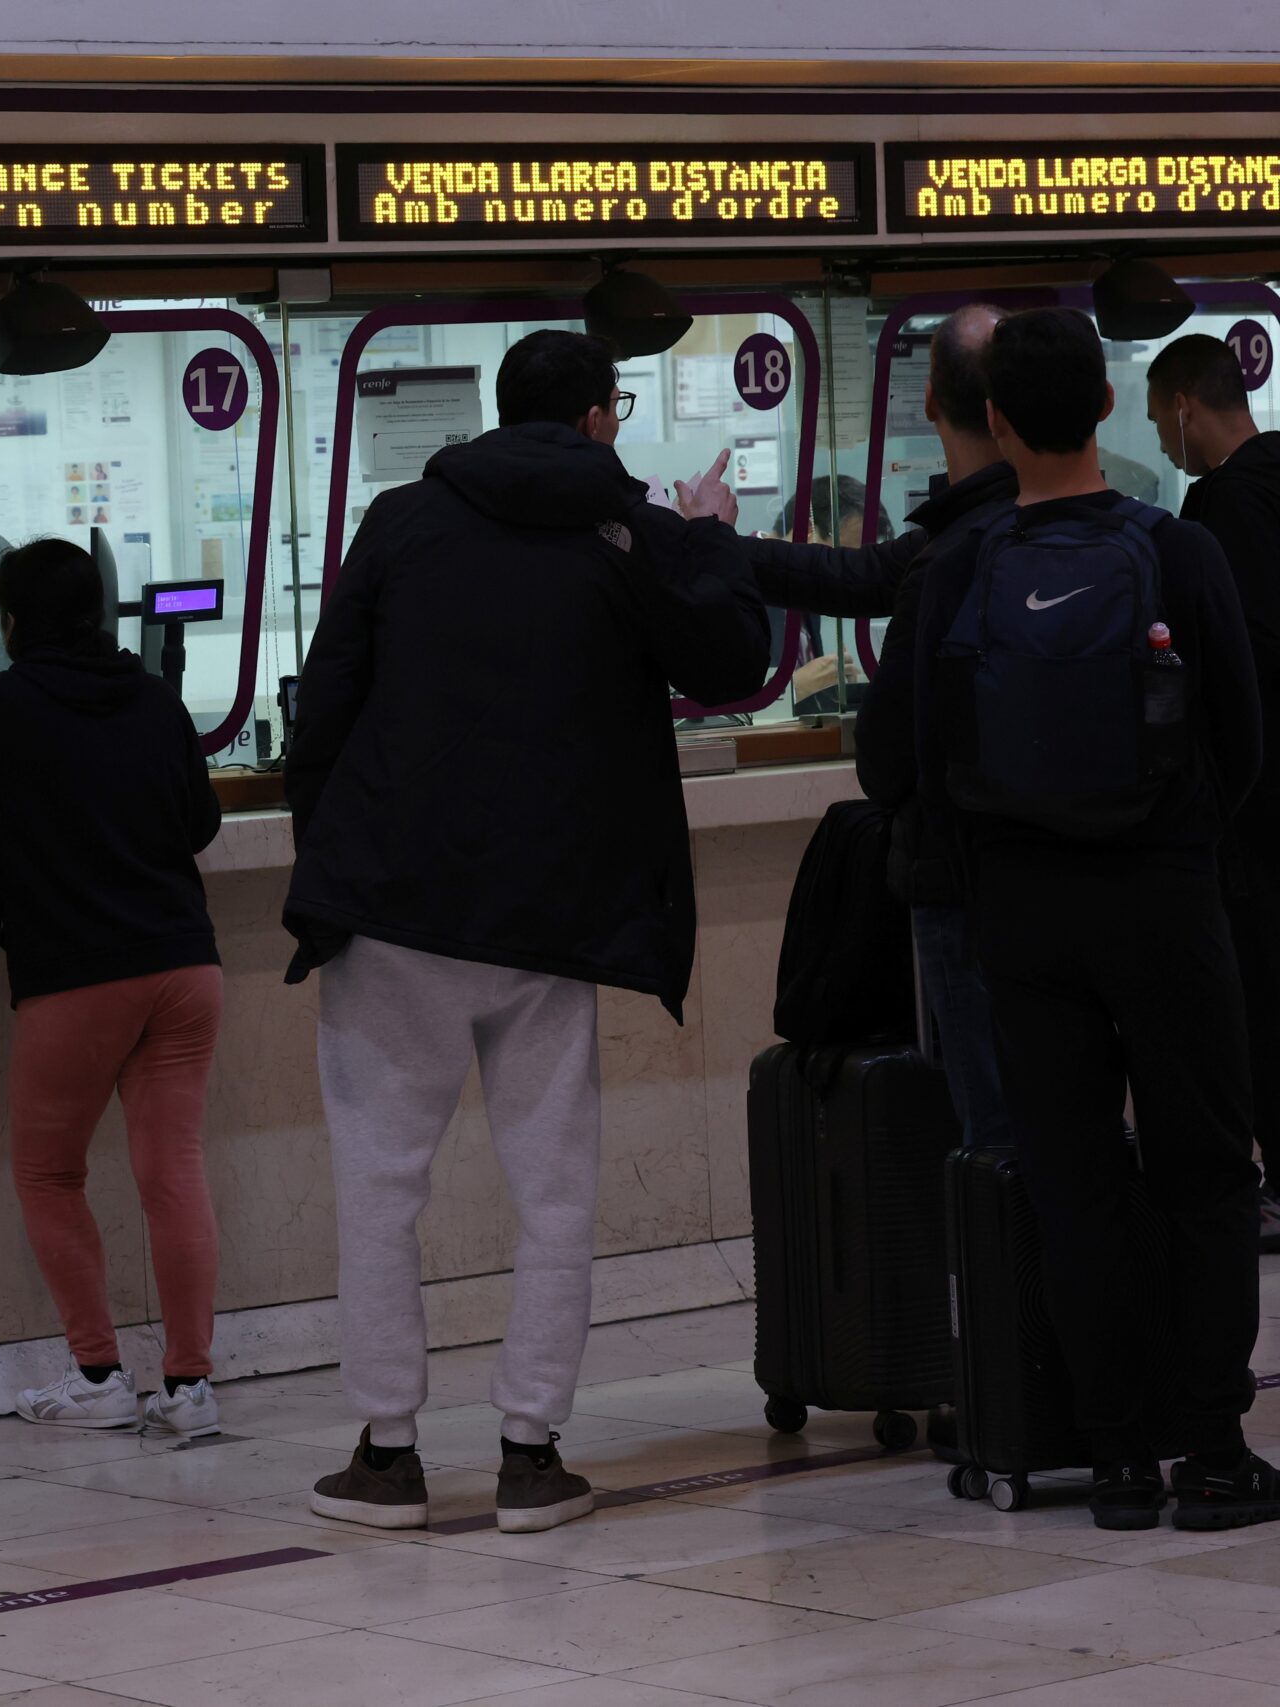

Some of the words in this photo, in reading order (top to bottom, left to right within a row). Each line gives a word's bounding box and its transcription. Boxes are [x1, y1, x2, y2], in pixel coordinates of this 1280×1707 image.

[112, 163, 289, 190] TICKETS
[387, 163, 499, 193] VENDA
[513, 162, 636, 191] LLARGA
[929, 159, 1026, 188] VENDA
[1038, 157, 1146, 186] LLARGA
[79, 194, 273, 225] number
[375, 193, 458, 223] Amb
[485, 199, 646, 222] numero
[672, 189, 838, 219] d'ordre
[918, 187, 991, 216] Amb
[1014, 192, 1155, 214] numero
[363, 377, 391, 390] renfe
[740, 349, 785, 394] 18
[189, 366, 240, 413] 17
[654, 1473, 743, 1493] renfe
